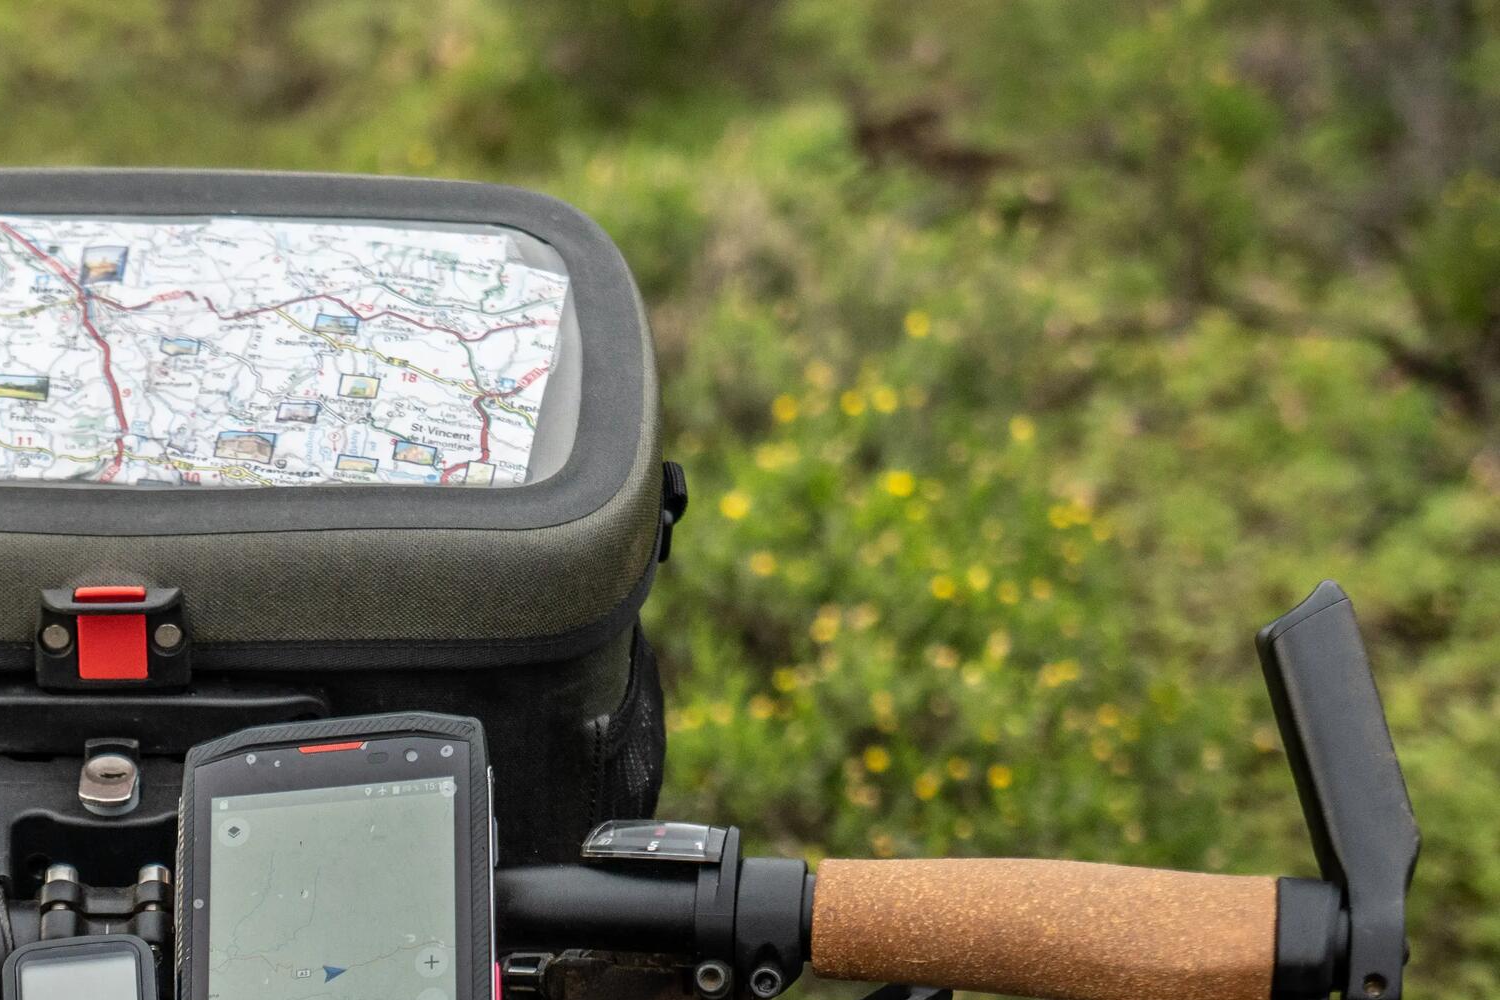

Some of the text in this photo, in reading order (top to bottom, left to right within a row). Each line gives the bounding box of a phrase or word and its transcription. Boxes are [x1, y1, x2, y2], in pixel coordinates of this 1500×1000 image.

[401, 372, 418, 383] 18
[17, 435, 32, 446] 11
[646, 840, 660, 852] 5
